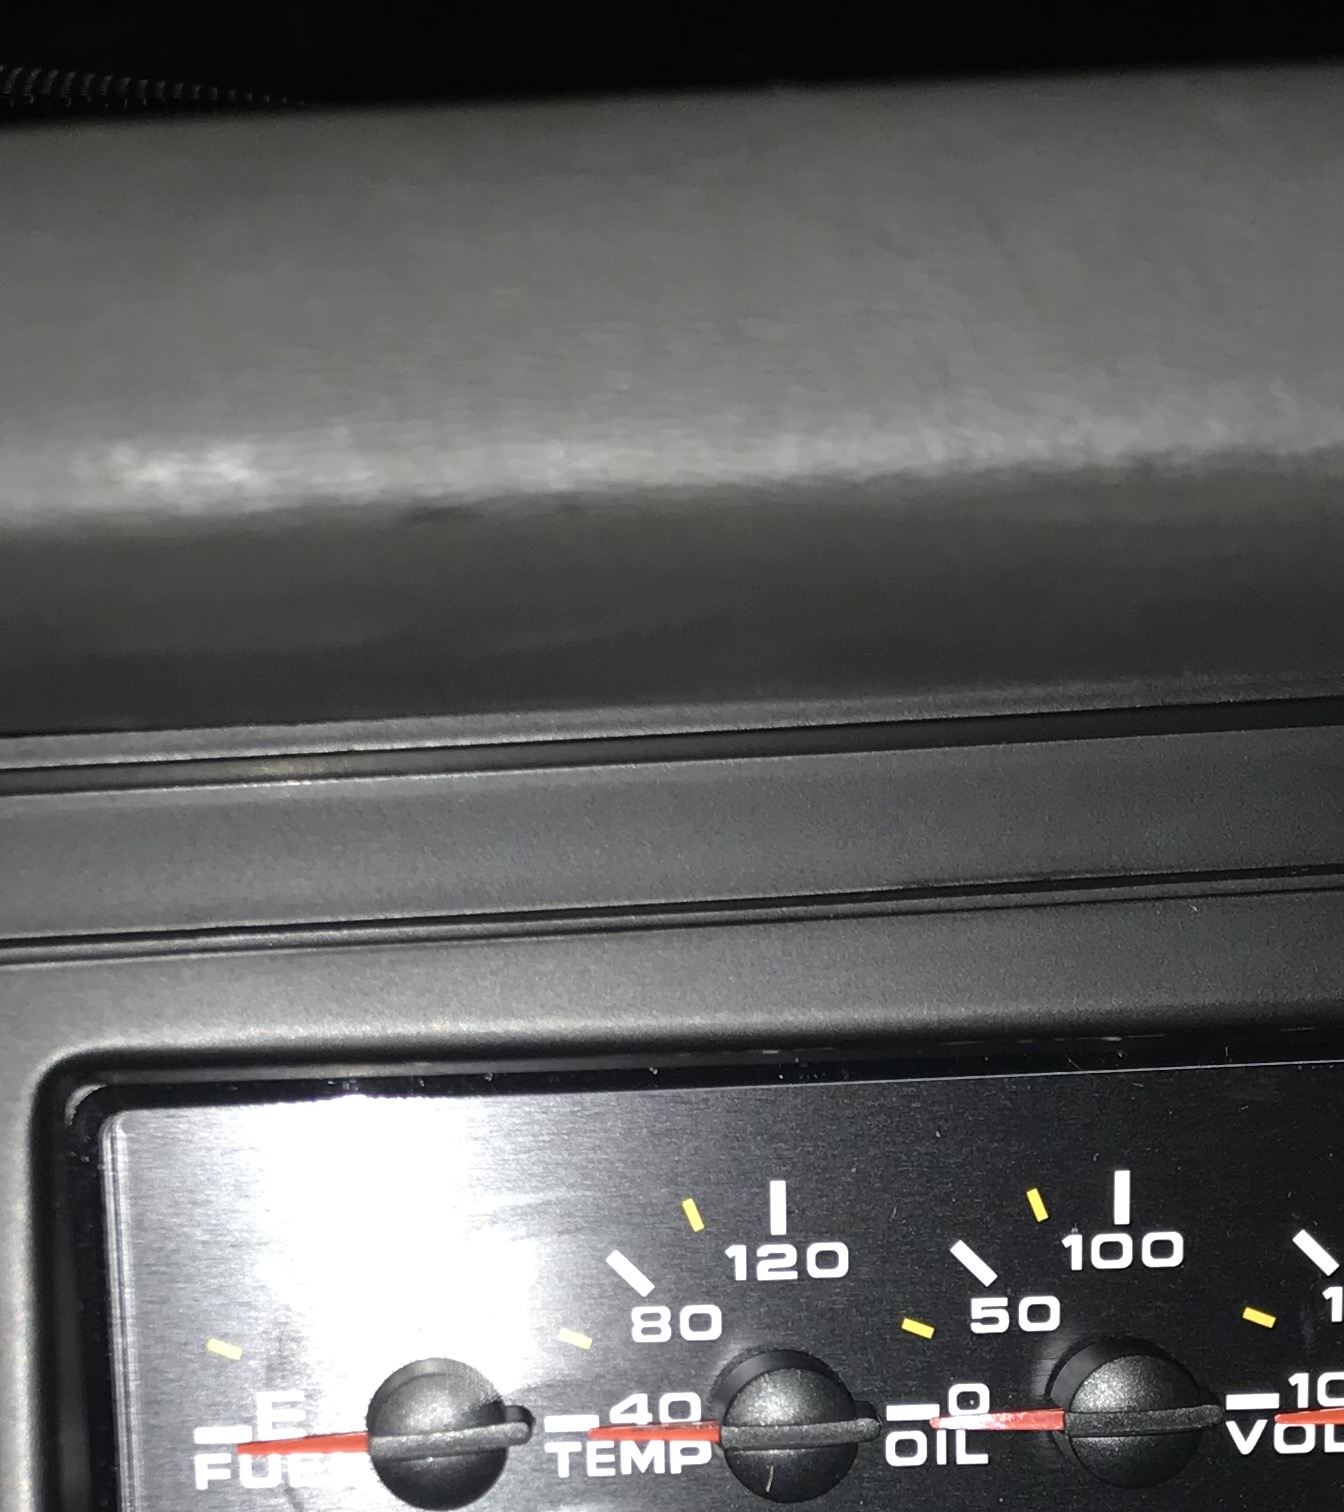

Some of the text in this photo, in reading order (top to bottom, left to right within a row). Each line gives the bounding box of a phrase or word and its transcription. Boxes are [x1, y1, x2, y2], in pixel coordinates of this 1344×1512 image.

[723, 1241, 850, 1282] 120
[1061, 1230, 1184, 1271] 100
[630, 1304, 723, 1343] 80
[970, 1295, 1061, 1334] 50
[609, 1391, 703, 1426] 40
[948, 1383, 991, 1416] 0
[545, 1440, 713, 1479] TEMP
[884, 1429, 989, 1467] OIL
[194, 1452, 360, 1490] FUE
